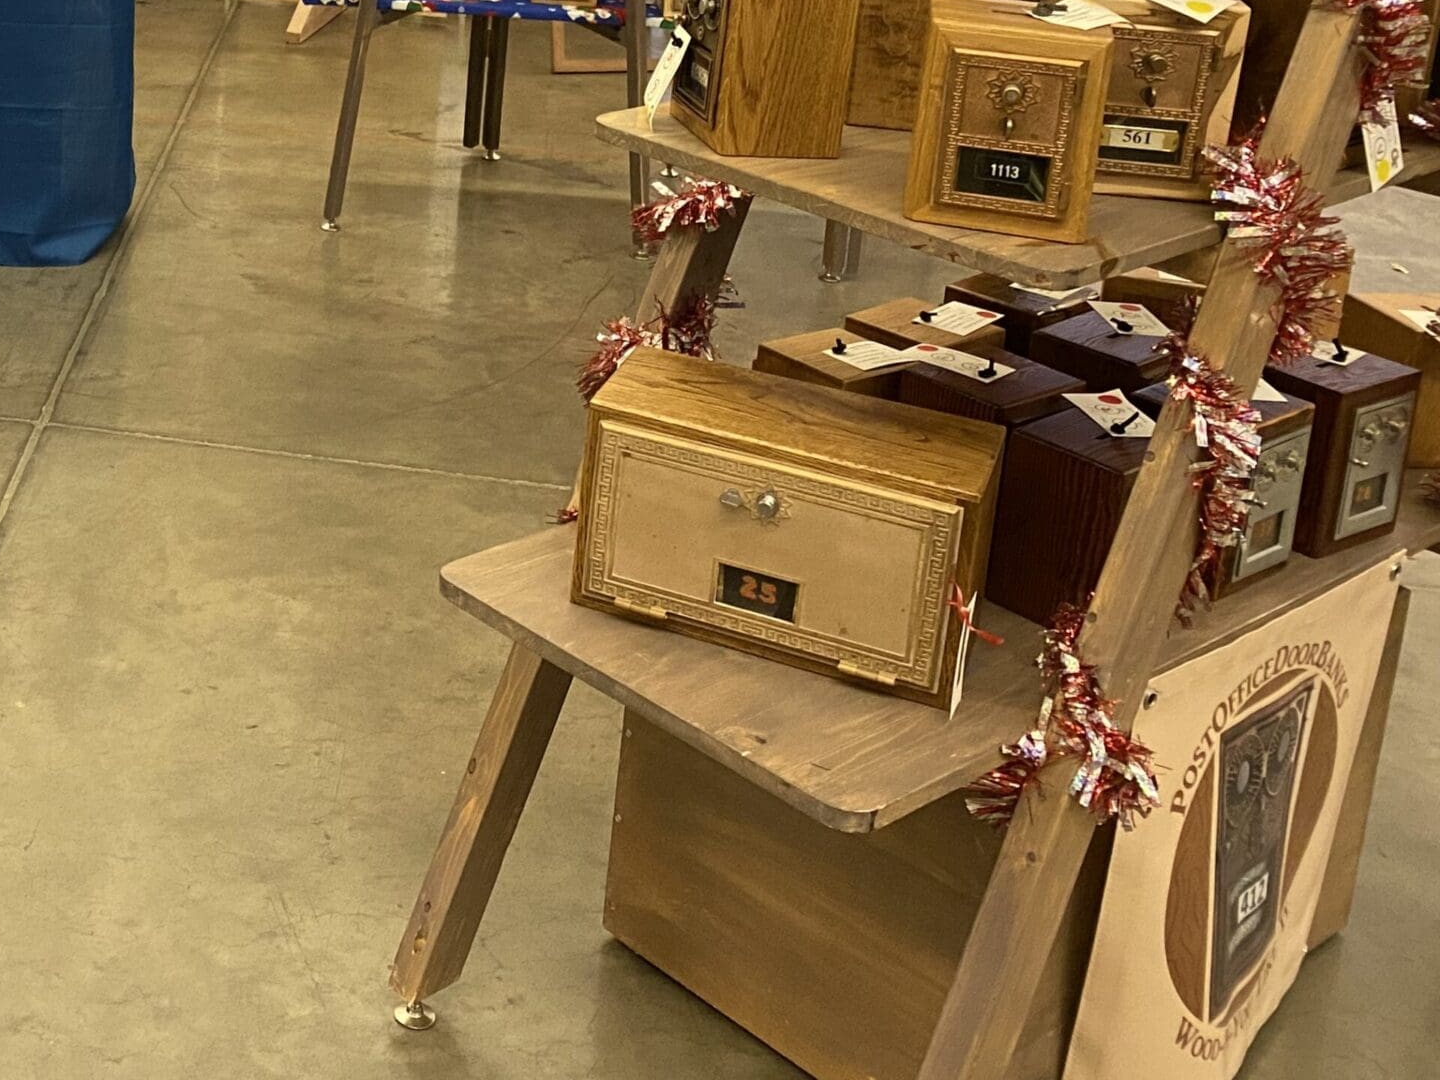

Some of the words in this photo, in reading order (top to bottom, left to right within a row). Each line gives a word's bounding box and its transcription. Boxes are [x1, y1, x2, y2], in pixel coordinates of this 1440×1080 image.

[1122, 129, 1152, 145] 561
[990, 163, 1020, 179] 1113
[739, 575, 777, 605] 25
